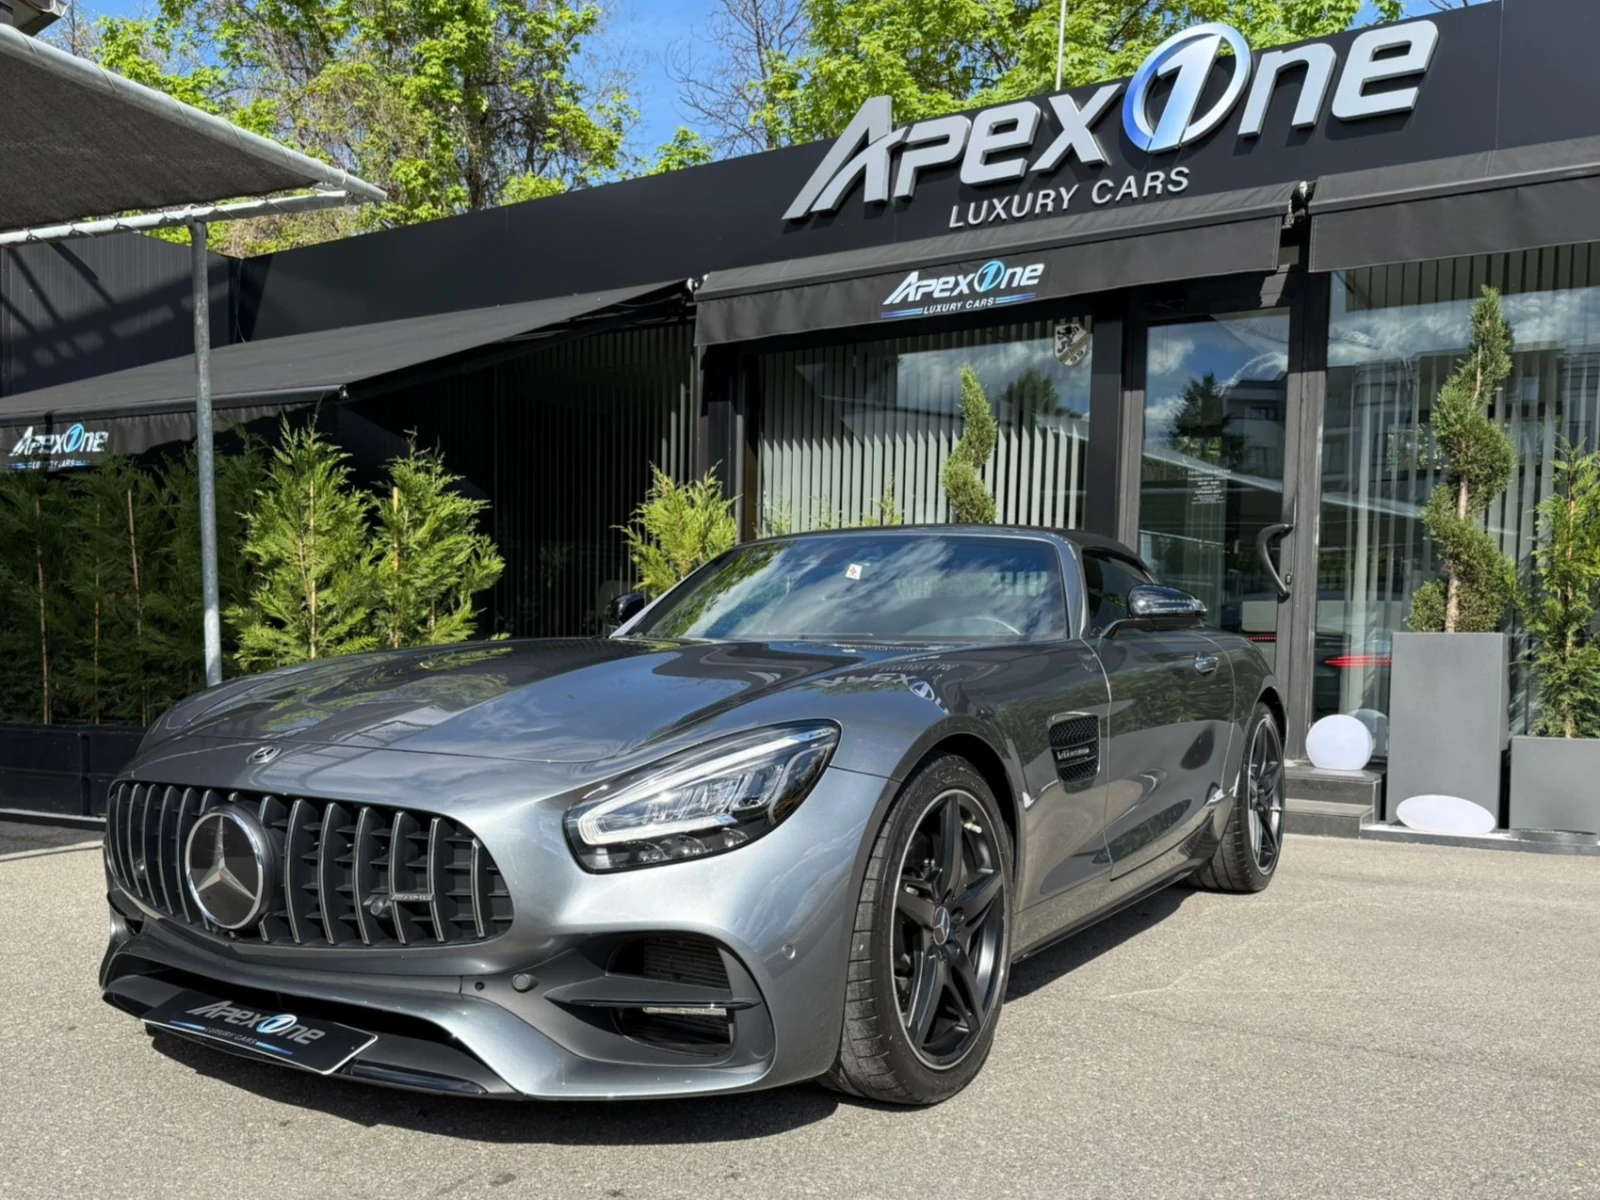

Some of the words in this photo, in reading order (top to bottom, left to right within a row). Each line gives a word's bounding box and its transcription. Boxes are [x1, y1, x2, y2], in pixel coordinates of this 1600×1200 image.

[949, 184, 1079, 228] LUXURY
[1091, 166, 1190, 204] CARS
[924, 301, 963, 315] LUXURY
[966, 297, 994, 310] CARS
